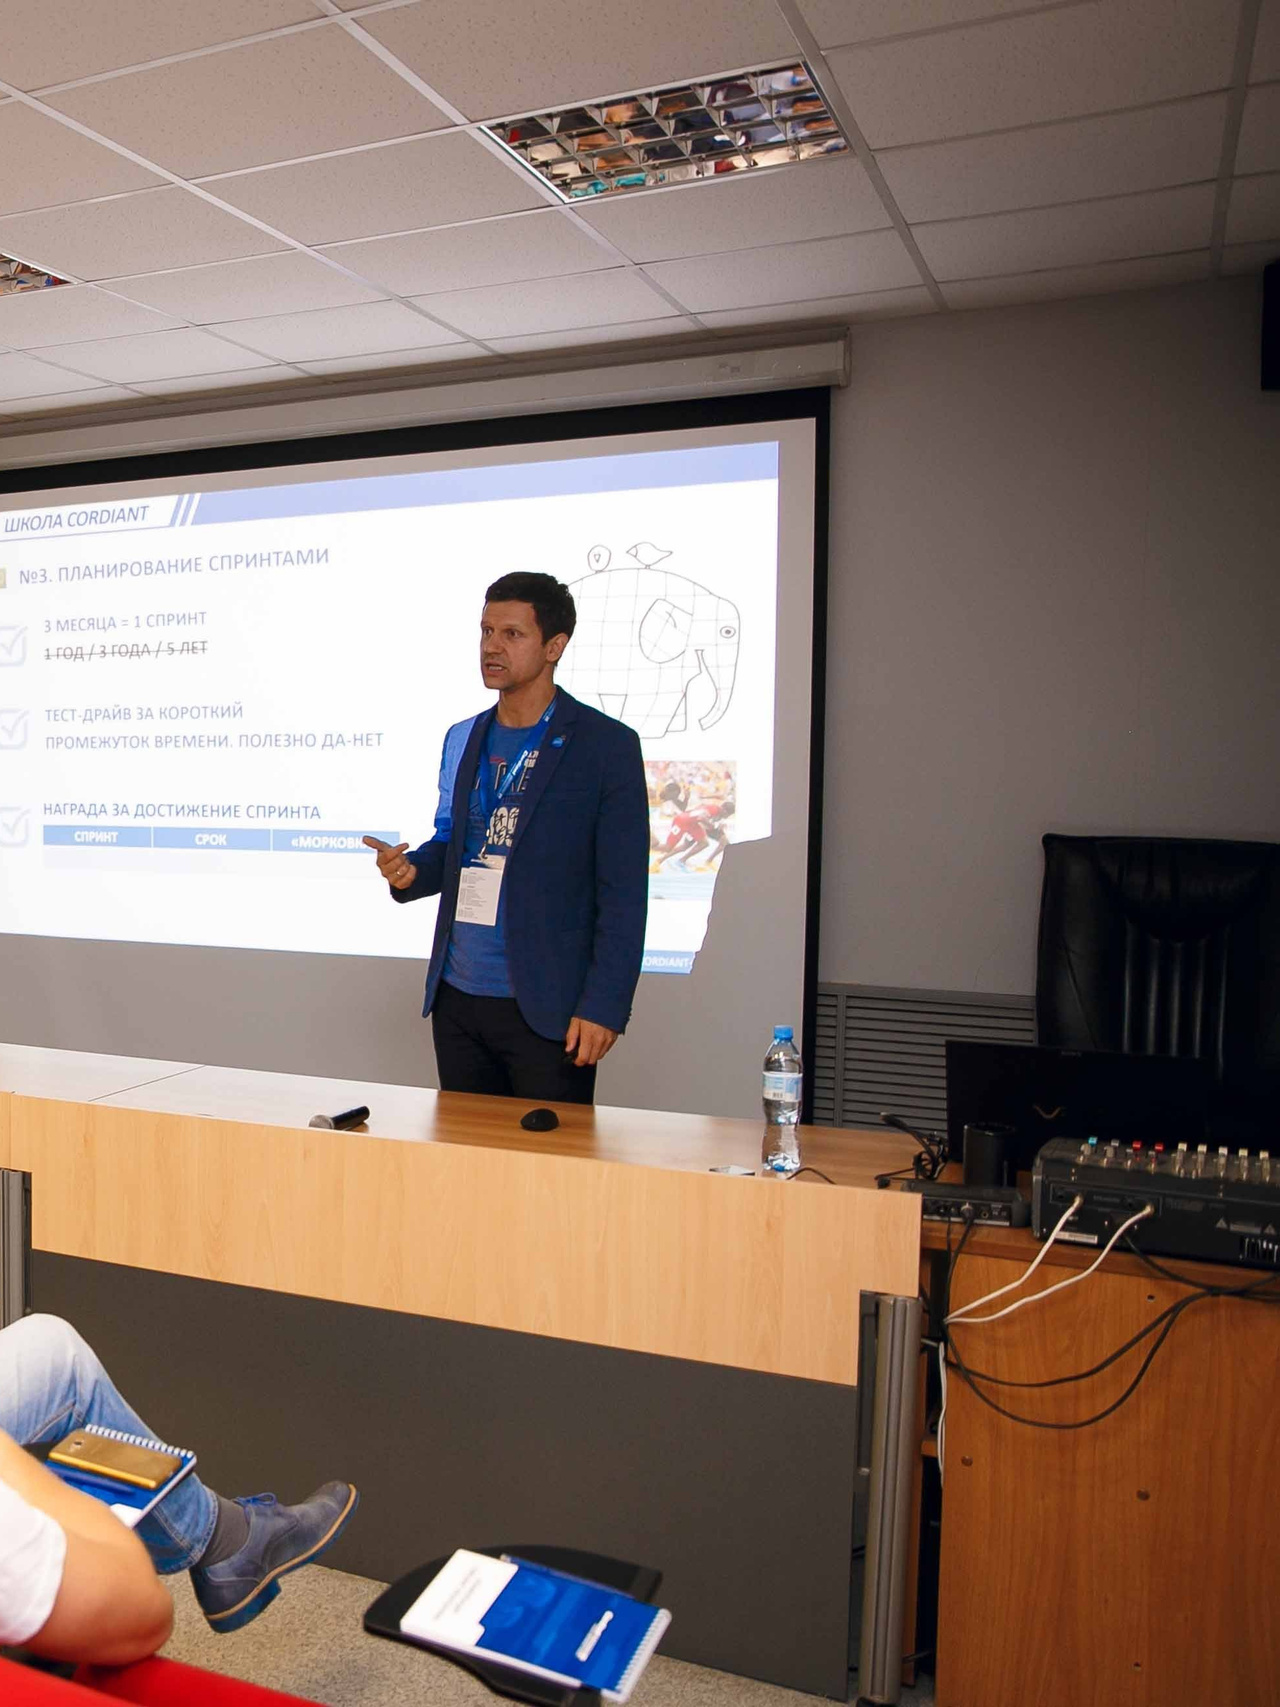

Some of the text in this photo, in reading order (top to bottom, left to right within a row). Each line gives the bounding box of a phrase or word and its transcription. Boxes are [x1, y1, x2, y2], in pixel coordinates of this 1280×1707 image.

[3, 505, 150, 534] ШКОЛА CORDIANT
[19, 547, 330, 586] №3. ПЛАНИРОВАНИЕ СПРИНТАМИ
[43, 619, 52, 633] 3
[56, 614, 117, 634] МЕСЯЦА
[134, 615, 141, 629] 1
[146, 611, 208, 628] СПРИНТ
[44, 646, 52, 660] 1
[56, 645, 85, 662] ГОД
[99, 643, 108, 658] 3
[111, 642, 152, 660] ГОДА
[167, 641, 175, 655] 5
[179, 640, 208, 656] ЛЕТ
[45, 702, 244, 724] ТЕСТ-ДРАЙВ ЗА КОРОТКИЙ
[45, 732, 384, 751] ПРОМЕЖУТОК ВРЕМЕНИ. ПОЛЕЗНО ДА-НЕТ
[43, 803, 321, 820] НАГРАДА ЗА ДОСТИЖЕНИЕ СПРИНТА
[74, 830, 118, 844] СПРИНТ
[195, 833, 227, 847] СРОК
[291, 836, 370, 850] «МОРКОВК
[643, 956, 690, 968] ORDIANT
